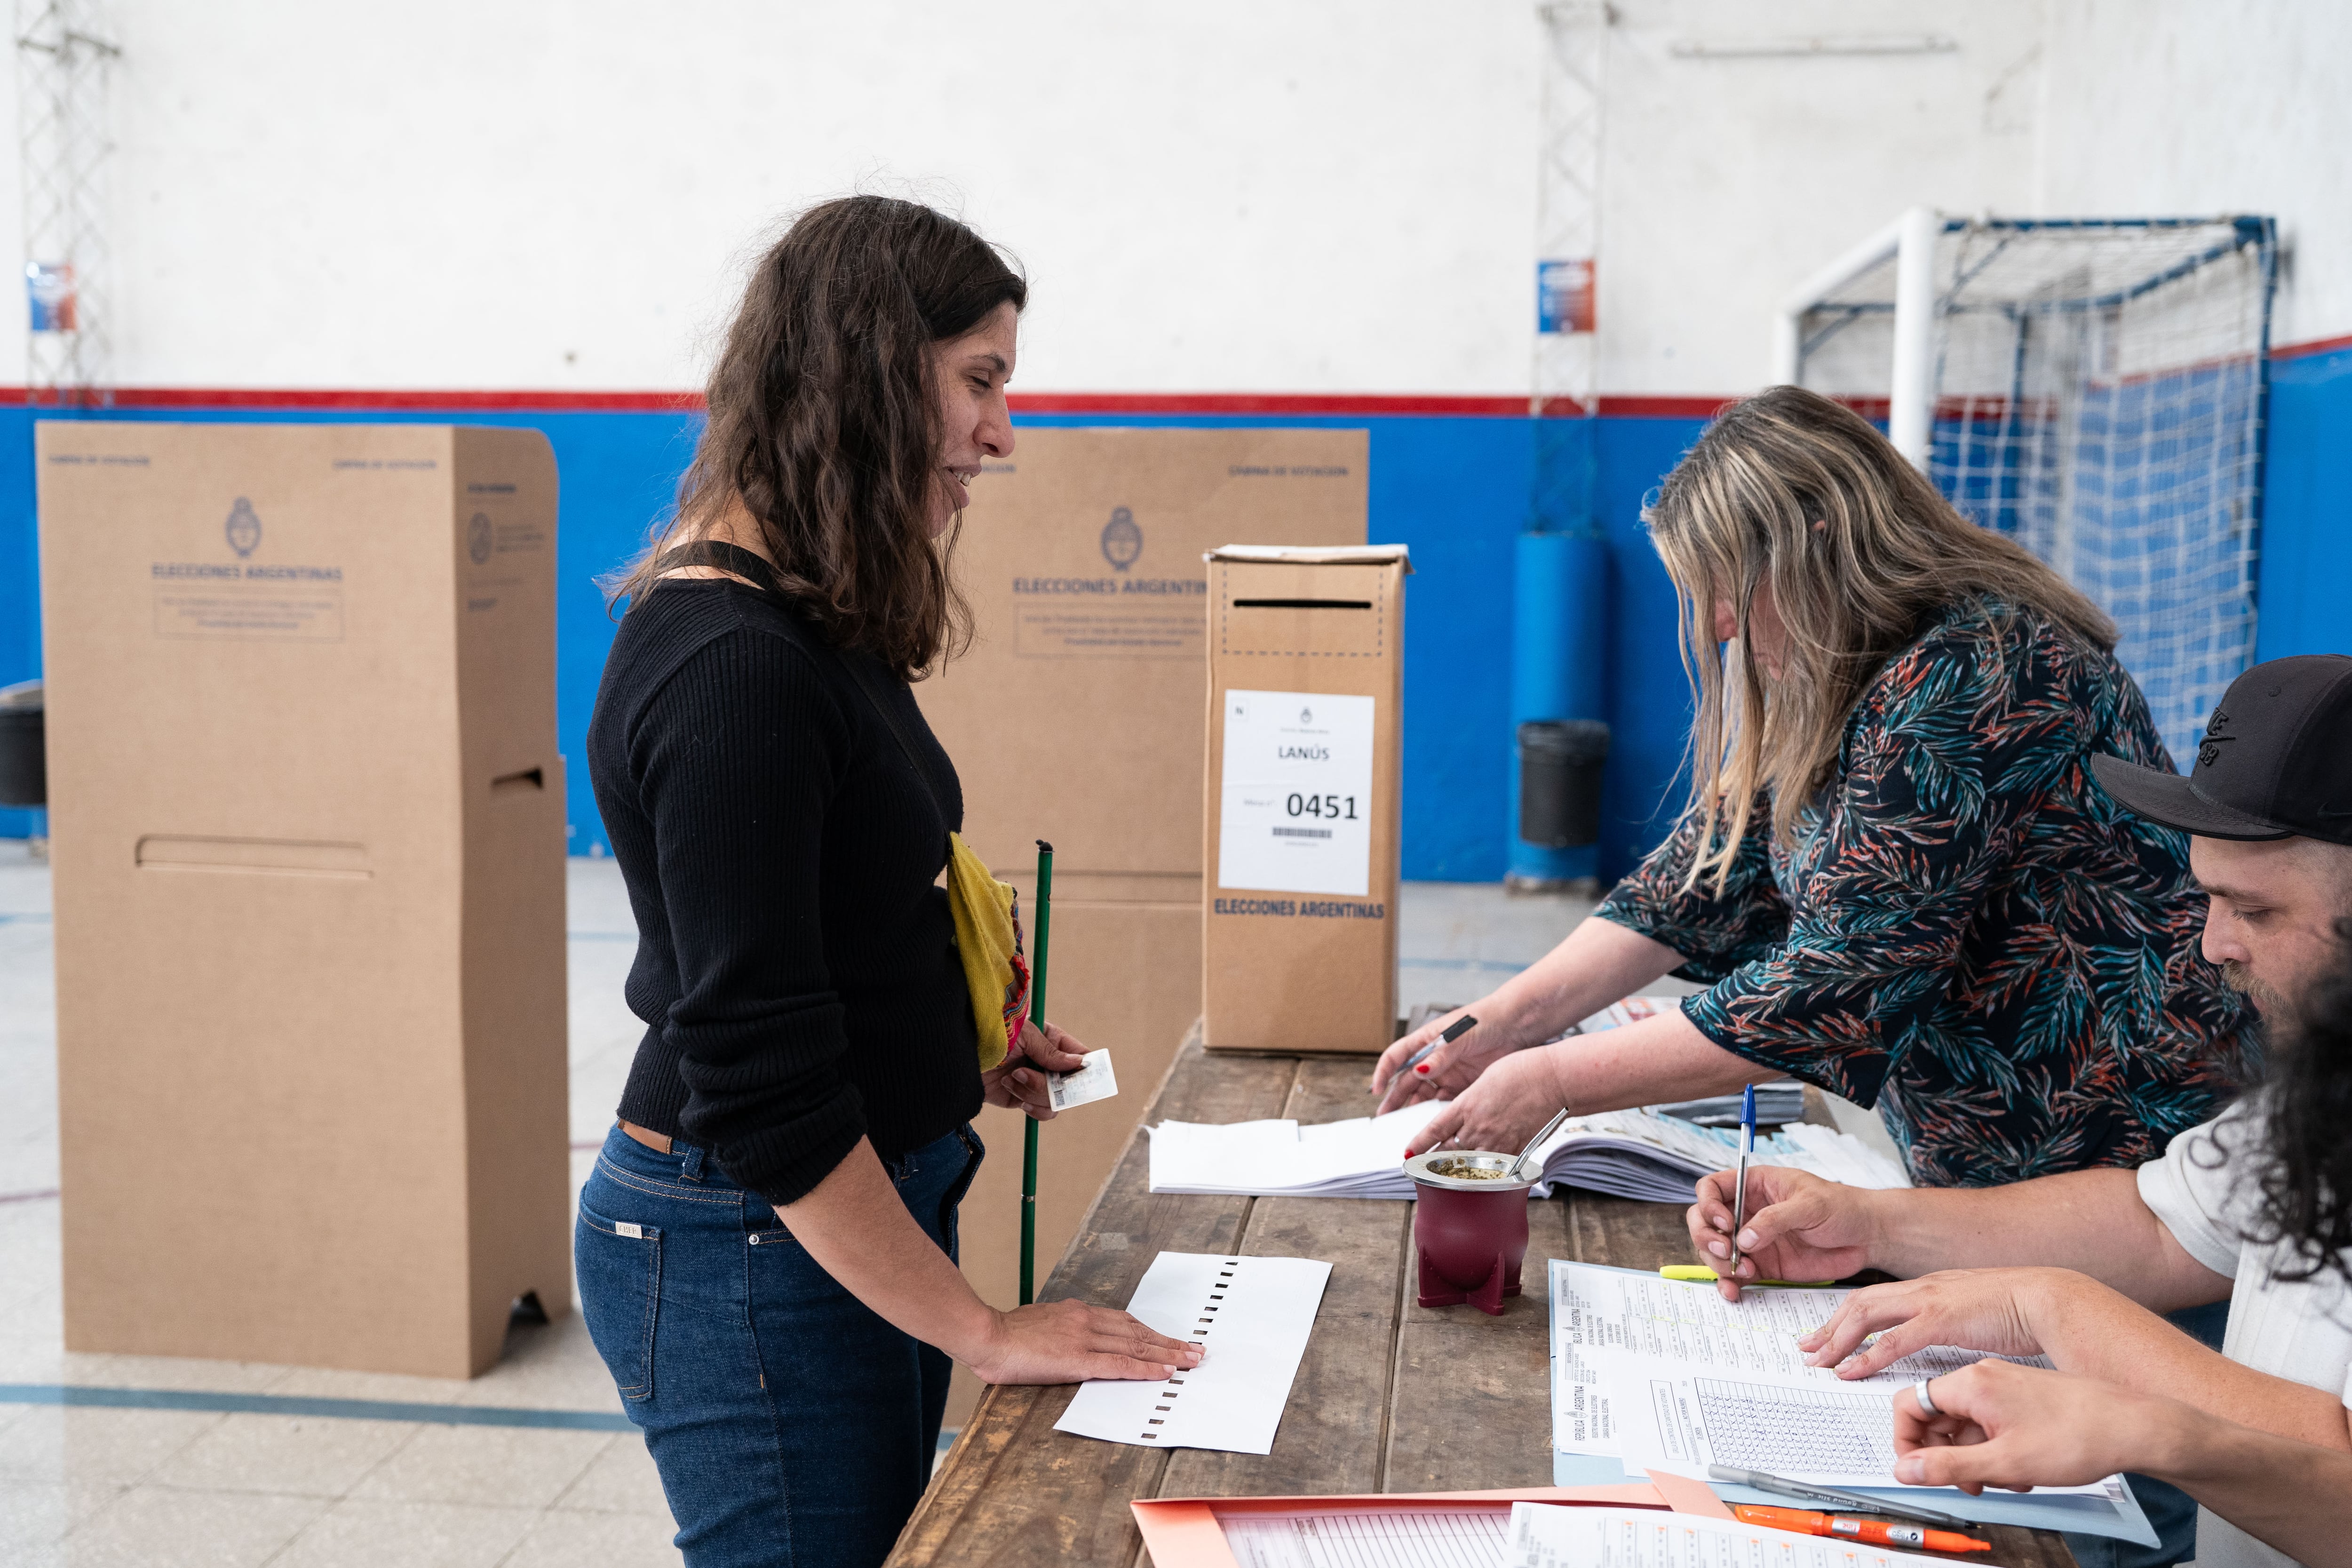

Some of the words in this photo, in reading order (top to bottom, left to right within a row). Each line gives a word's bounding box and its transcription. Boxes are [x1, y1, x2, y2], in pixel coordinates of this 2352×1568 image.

[1012, 578, 1118, 596] ELECCIONES
[1278, 743, 1330, 761] LANÚS
[1287, 793, 1358, 819] 0451
[1214, 898, 1295, 915] ELECCIONES
[1300, 900, 1384, 919] ARGENTINAS
[1572, 1309, 1581, 1327] ARGENTINA
[1574, 1386, 1584, 1411] ARGENTINA
[1833, 1498, 1857, 1506] Round
